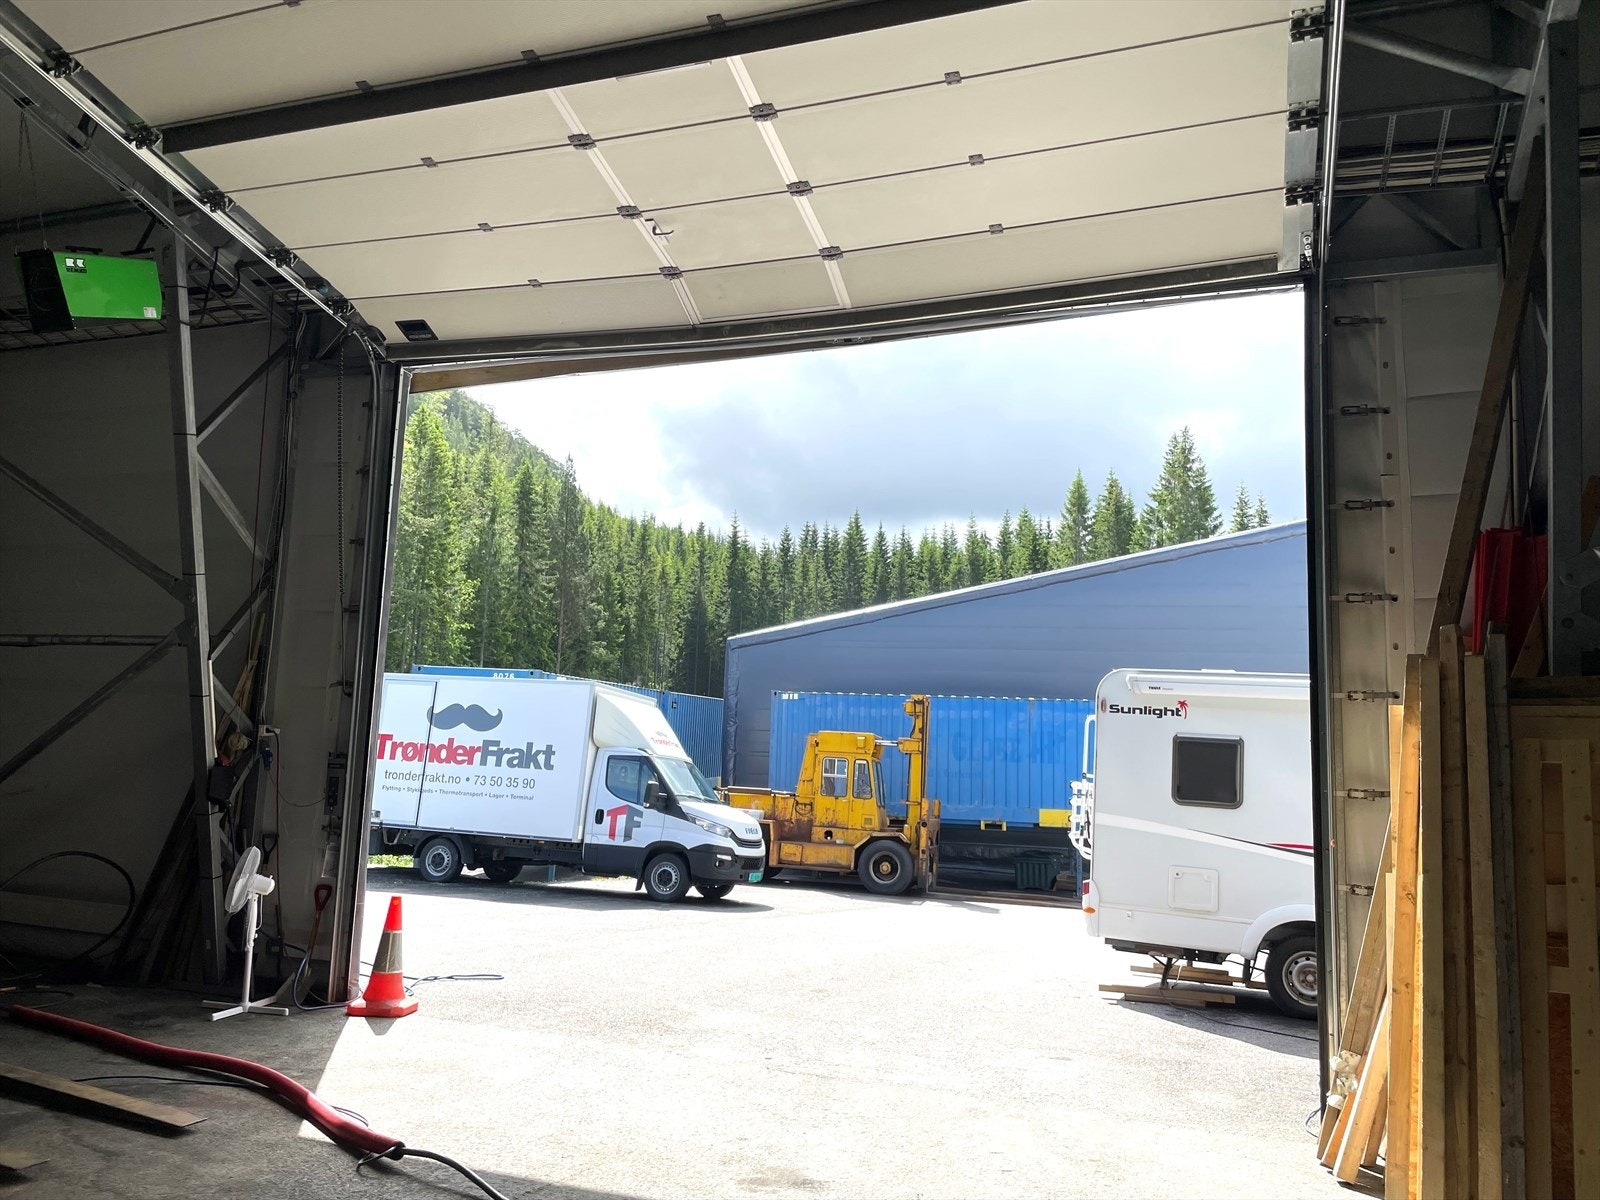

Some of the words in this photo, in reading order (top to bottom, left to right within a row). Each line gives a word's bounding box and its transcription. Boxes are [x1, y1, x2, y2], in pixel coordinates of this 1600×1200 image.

[1109, 704, 1182, 718] Sunlight
[384, 769, 461, 785] tronderrakt.no
[474, 774, 487, 787] 73
[489, 775, 503, 788] 50
[505, 776, 519, 789] 35
[522, 777, 536, 790] 90
[489, 792, 505, 800] Lager
[510, 793, 535, 801] Terminal
